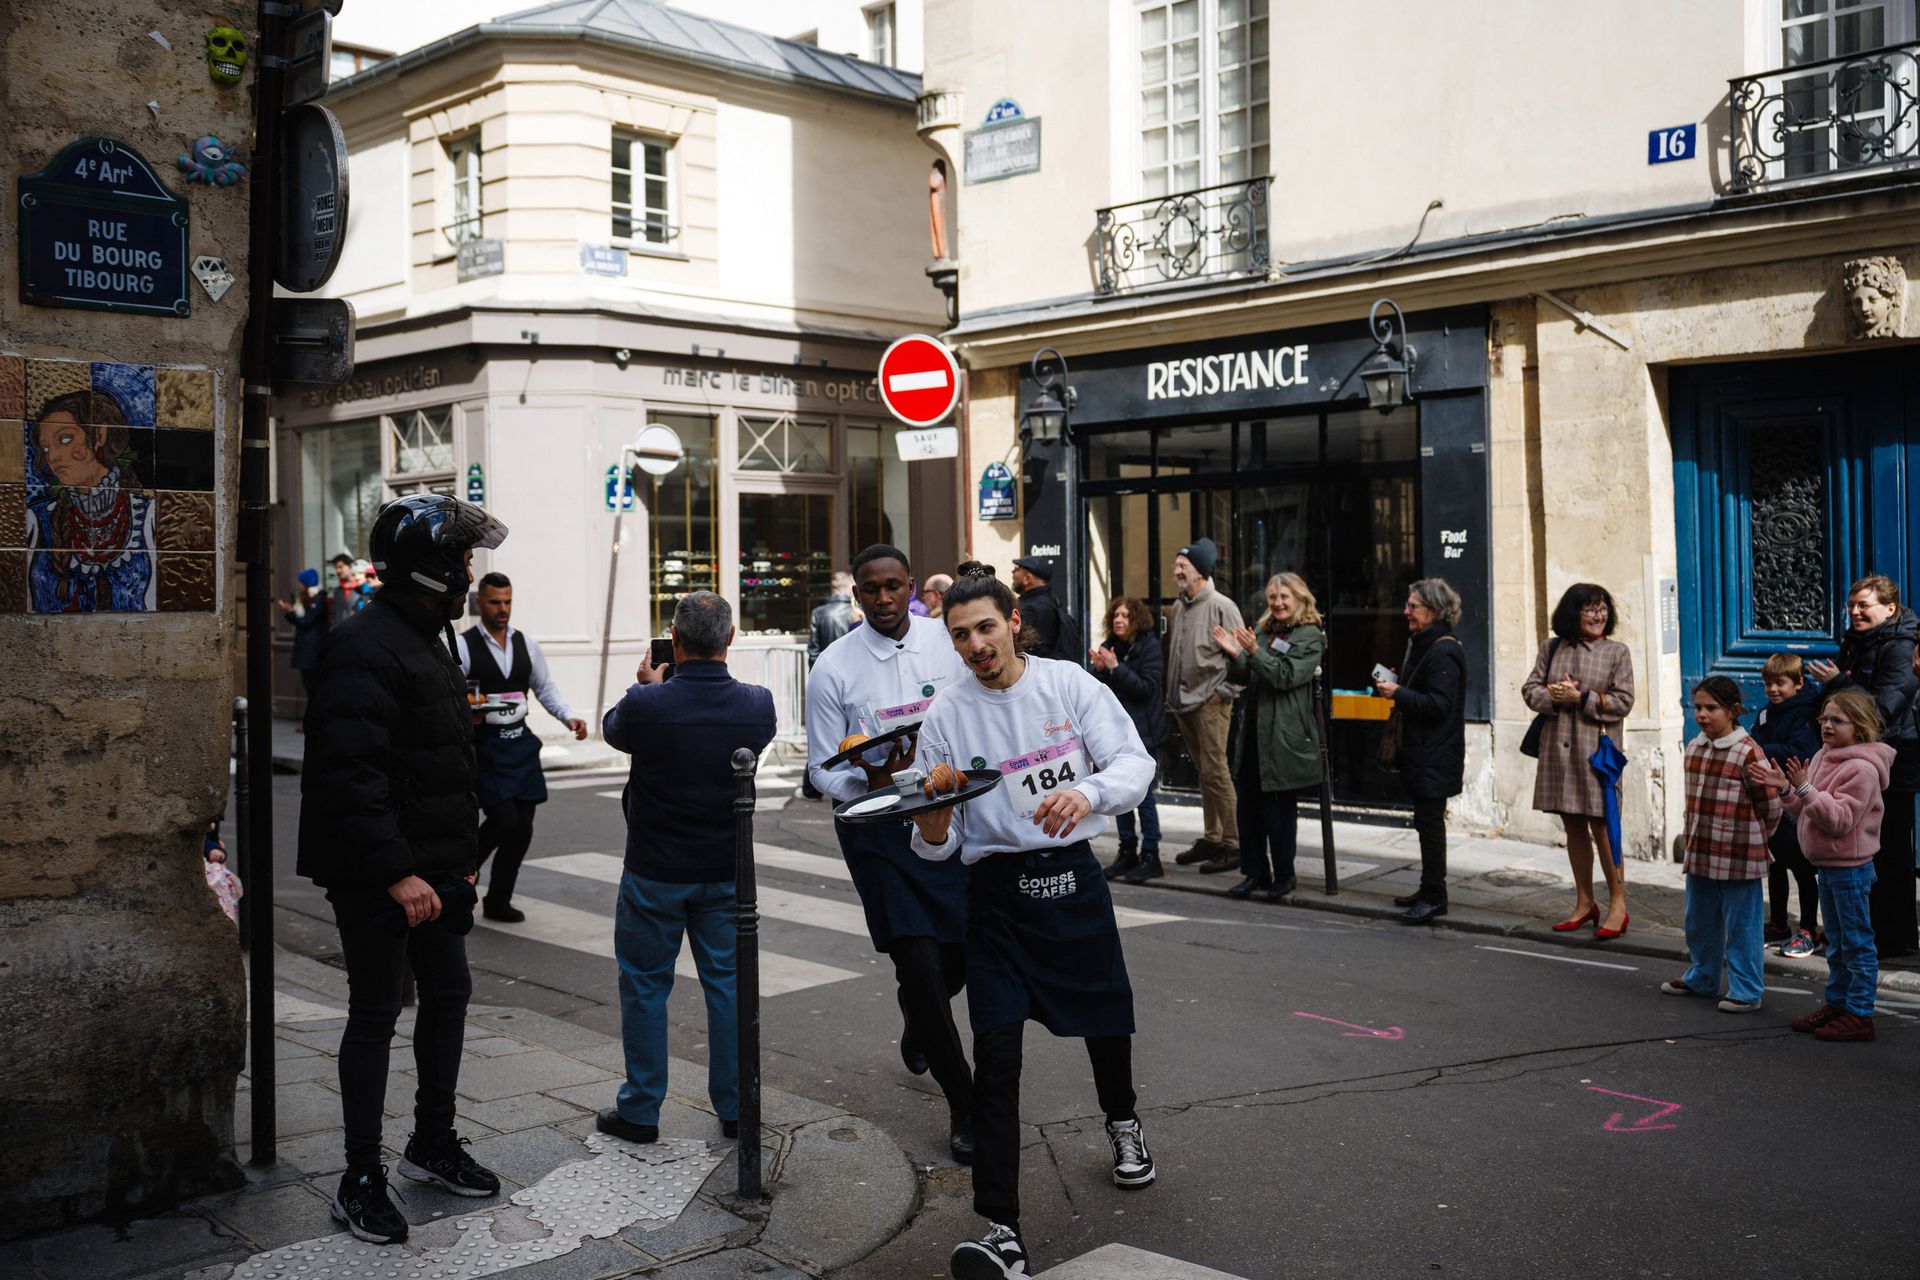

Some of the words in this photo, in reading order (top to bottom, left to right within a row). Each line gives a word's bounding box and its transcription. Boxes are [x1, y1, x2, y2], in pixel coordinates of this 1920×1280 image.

[1658, 129, 1686, 160] 16
[75, 158, 96, 179] 4e
[98, 161, 134, 184] Arrt
[88, 219, 128, 242] RUE
[54, 241, 81, 262] DU
[92, 245, 162, 270] BOURG
[65, 268, 155, 293] TIBOURG
[663, 367, 721, 390] marc
[732, 368, 750, 391] le
[760, 371, 818, 396] bihan
[1147, 344, 1309, 400] RESISTANCE
[1440, 529, 1467, 544] Food
[1444, 546, 1464, 558] Bar
[1021, 761, 1075, 795] 184
[1018, 870, 1075, 889] COURSE
